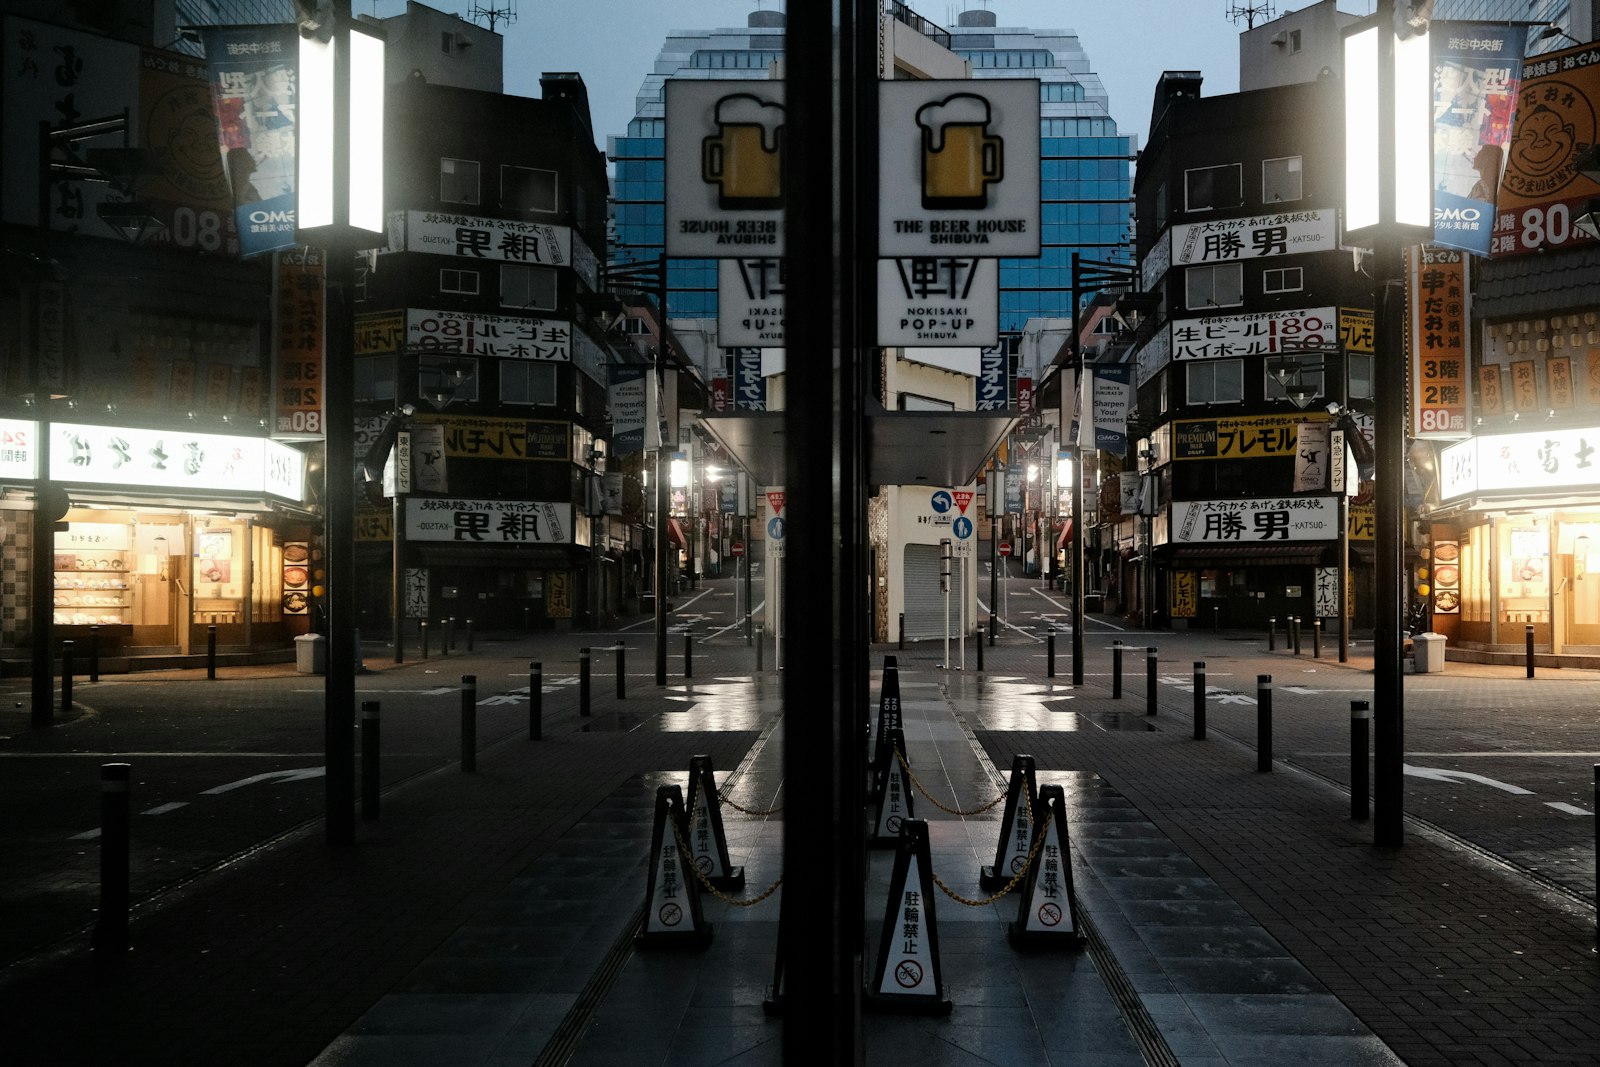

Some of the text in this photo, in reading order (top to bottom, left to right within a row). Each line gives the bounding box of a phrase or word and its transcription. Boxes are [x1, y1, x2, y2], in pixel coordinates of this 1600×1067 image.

[894, 220, 1026, 234] THE BEER HOUSE
[930, 234, 989, 244] SHIBUYA
[1202, 226, 1288, 261] 勝男
[1422, 251, 1460, 263] おでん
[907, 307, 968, 315] NOKISAKI
[1421, 269, 1446, 350] 串だおれ
[900, 319, 974, 330] POP-UP
[1174, 323, 1267, 343] 生ビール
[1174, 342, 1268, 359] ハイボール
[1425, 360, 1460, 379] 3階
[1094, 400, 1125, 408] Sharpen
[1425, 386, 1460, 404] 2階
[1422, 410, 1464, 430] 80席
[1177, 431, 1216, 444] PREMIUM
[1218, 428, 1297, 456] プレモル
[1333, 435, 1343, 487] 東急プラザ
[1202, 510, 1290, 540] 勝男
[1317, 569, 1331, 604] ハイボール
[884, 698, 890, 711] NO
[891, 698, 898, 711] NO
[1015, 806, 1028, 852] 駐輪禁止
[1044, 845, 1058, 898] 駐輪禁止
[902, 891, 920, 955] 駐輪禁止
